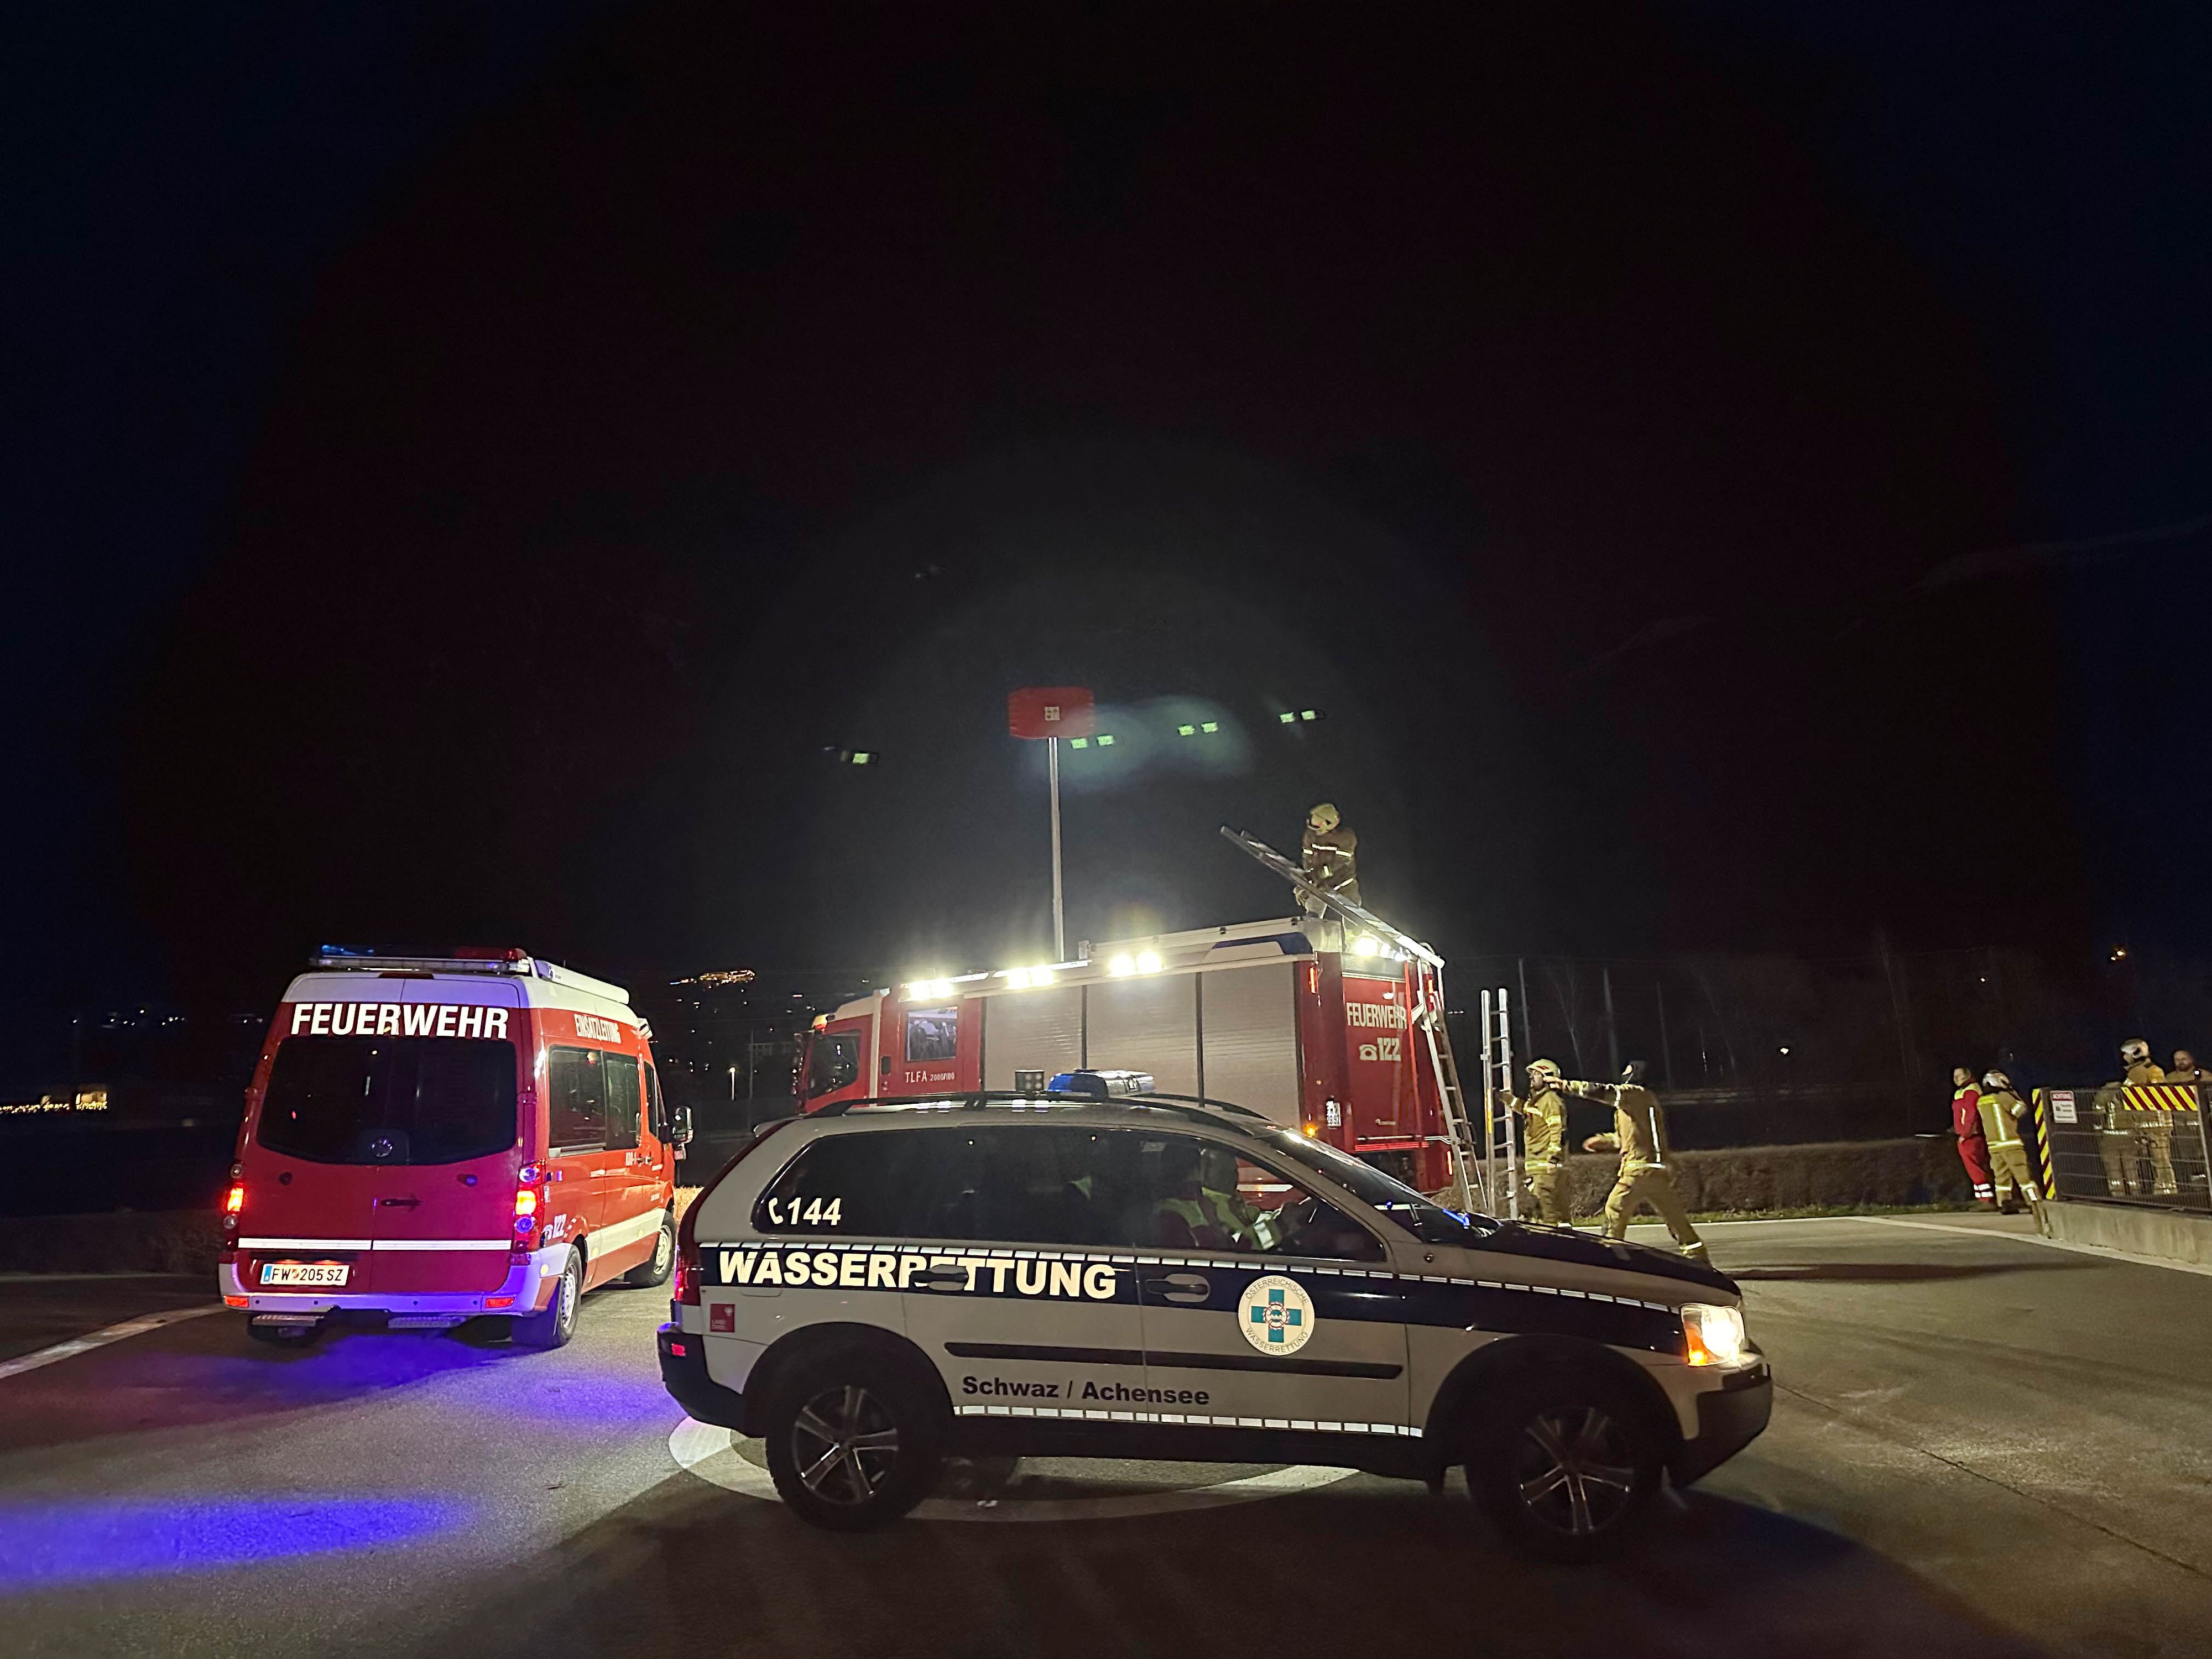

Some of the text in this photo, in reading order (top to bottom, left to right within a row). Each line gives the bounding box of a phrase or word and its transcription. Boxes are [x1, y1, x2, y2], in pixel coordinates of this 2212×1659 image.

[291, 1003, 509, 1039] FEUERWEHR
[1346, 1002, 1407, 1029] FEUERWEHR
[1376, 1037, 1401, 1061] 122
[905, 1071, 927, 1083] TLFA
[787, 1197, 841, 1225] 144
[552, 1213, 567, 1239] 122
[272, 1268, 343, 1281] FW 205 SZ
[719, 1251, 1116, 1299] WASSERRTTUNG
[1245, 1278, 1309, 1304] ÖSTERREICHISCHE
[1246, 1328, 1308, 1353] WASSERRETTUNG
[962, 1376, 1059, 1398] Schwaz
[1081, 1381, 1210, 1405] Achensee
